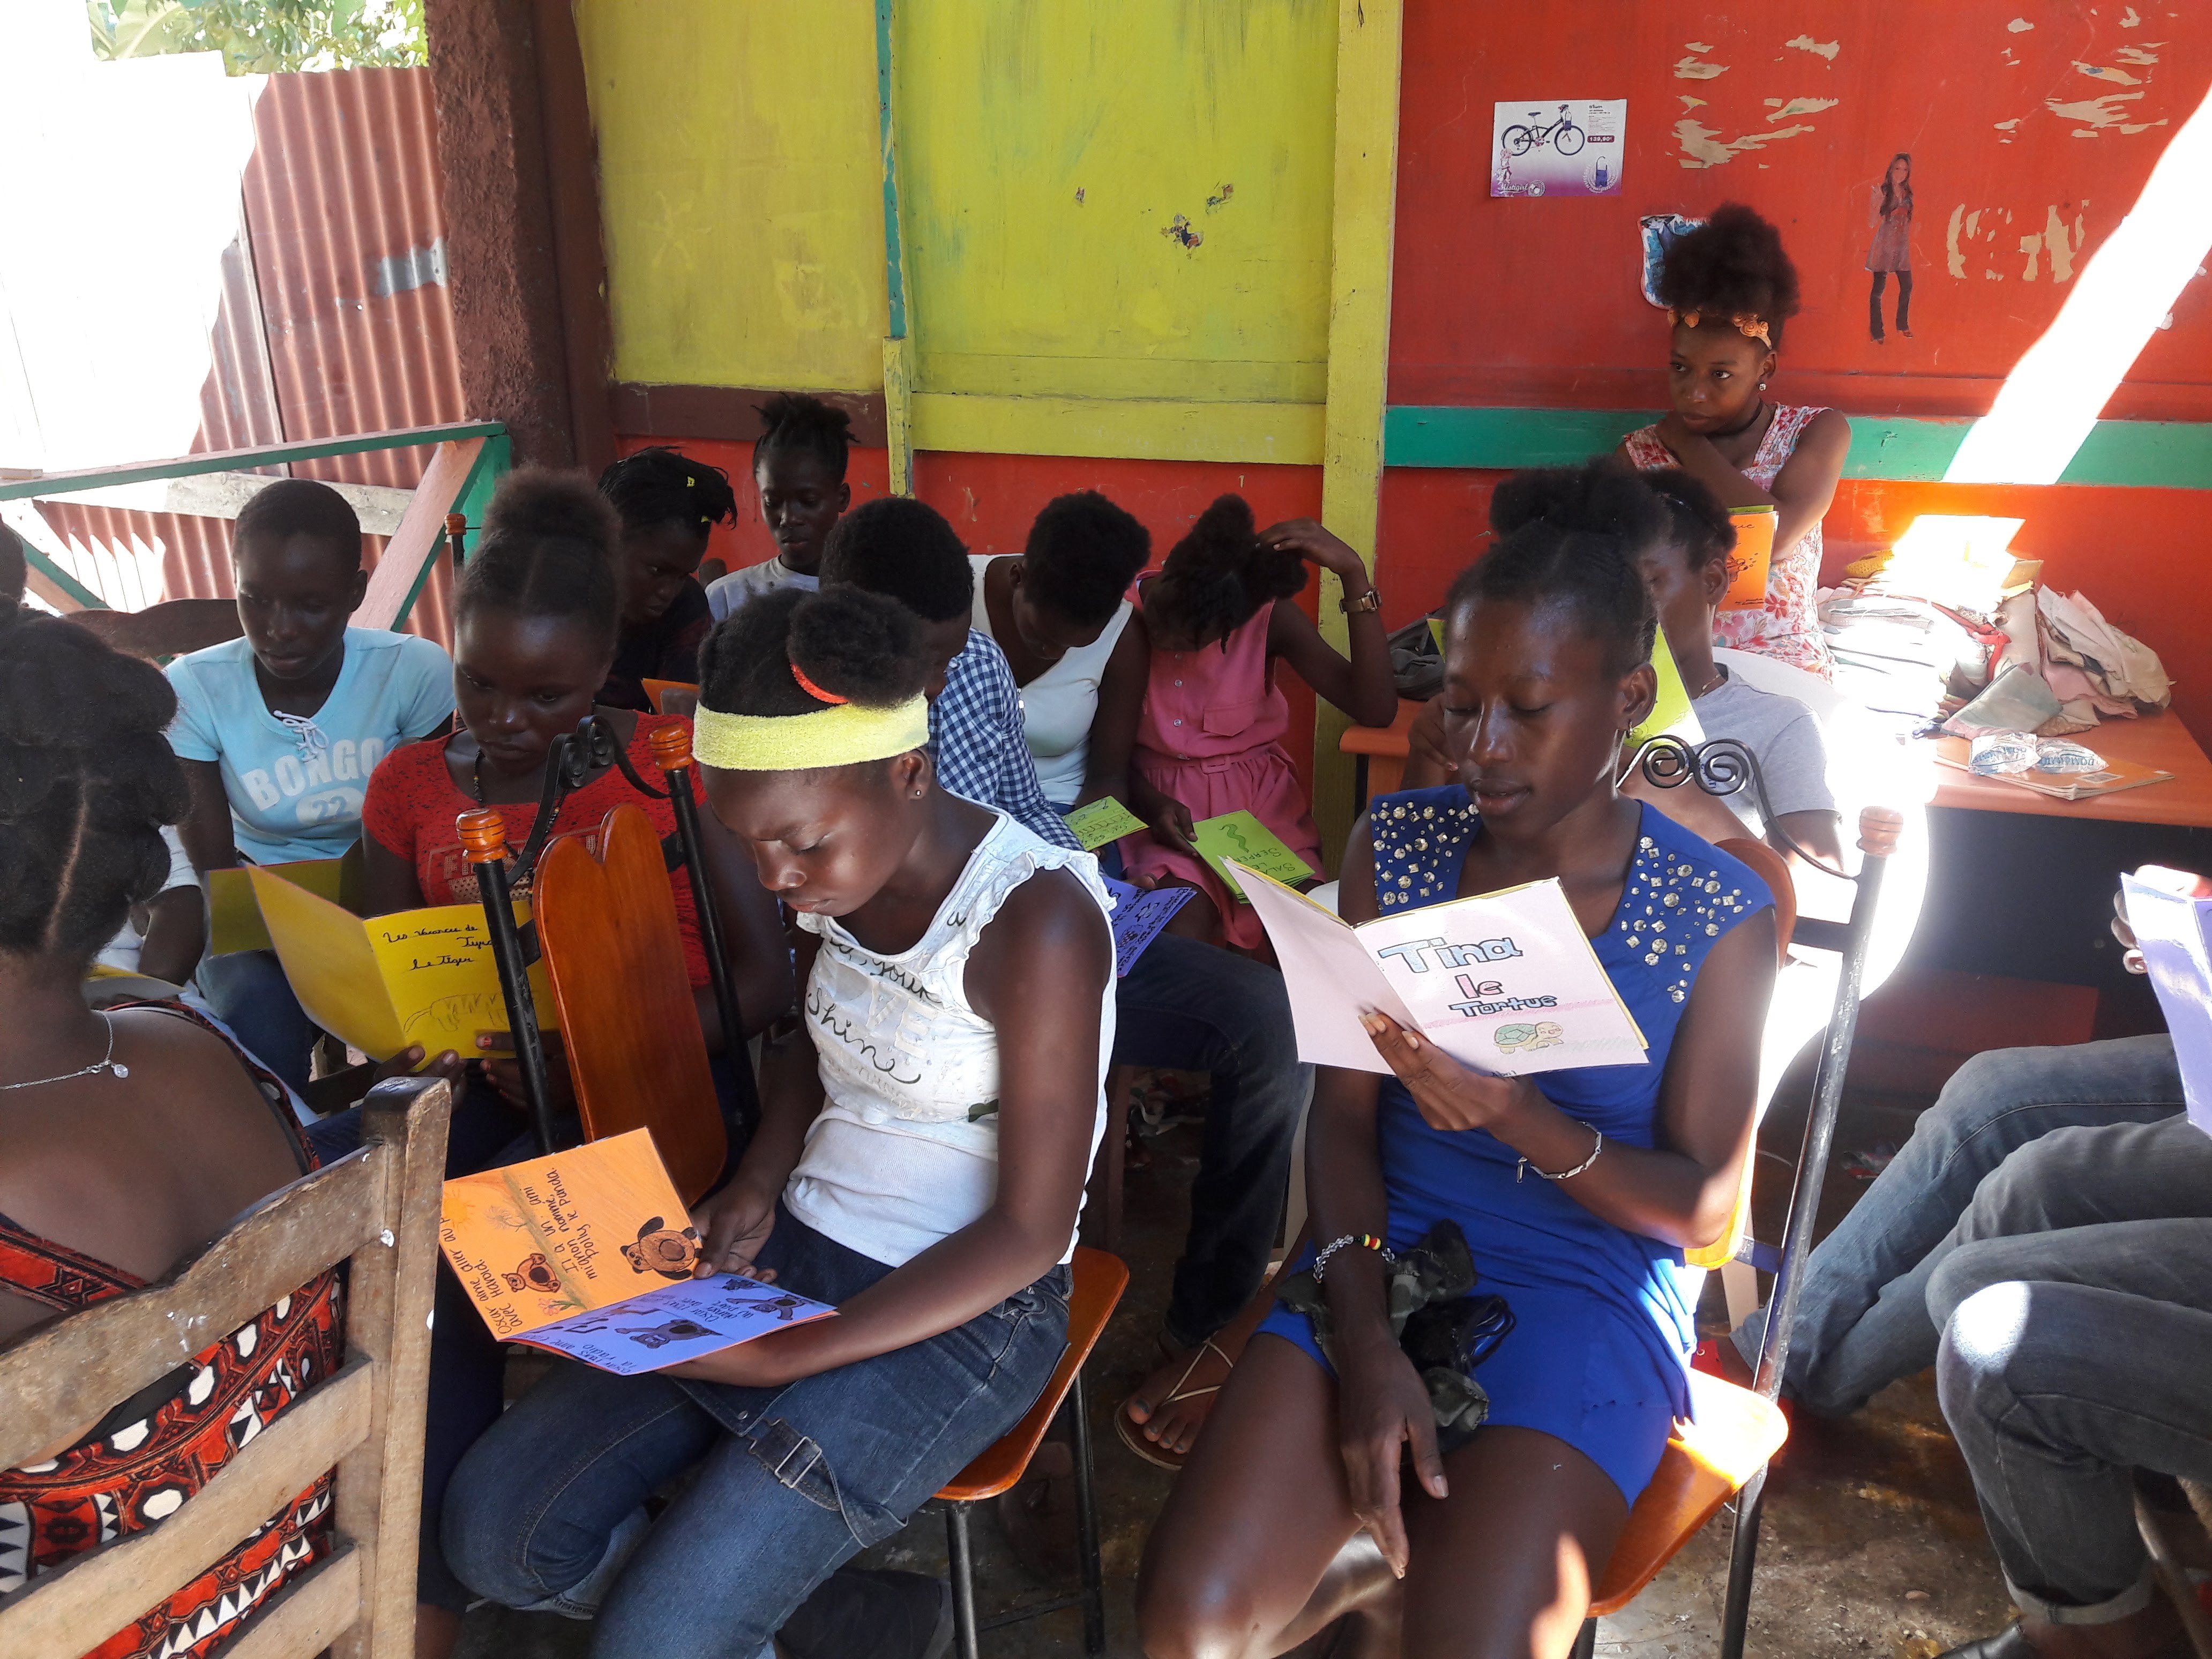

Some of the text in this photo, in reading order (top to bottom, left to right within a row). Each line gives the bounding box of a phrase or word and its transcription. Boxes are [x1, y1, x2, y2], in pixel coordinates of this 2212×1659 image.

[242, 737, 385, 811] BONGO
[1235, 848, 1281, 862] SERPEN
[1377, 937, 1523, 974] Tina
[1454, 973, 1505, 999] le
[1448, 993, 1558, 1017] Tortue
[808, 988, 921, 1084] Shine
[567, 1210, 579, 1221] le
[440, 1228, 457, 1243] au
[519, 1186, 579, 1273] Il a un ami
[449, 1249, 474, 1273] aller
[566, 1238, 597, 1280] mignon
[485, 1305, 512, 1334] Oscar
[499, 1303, 523, 1327] avec
[582, 1344, 617, 1361] radio
